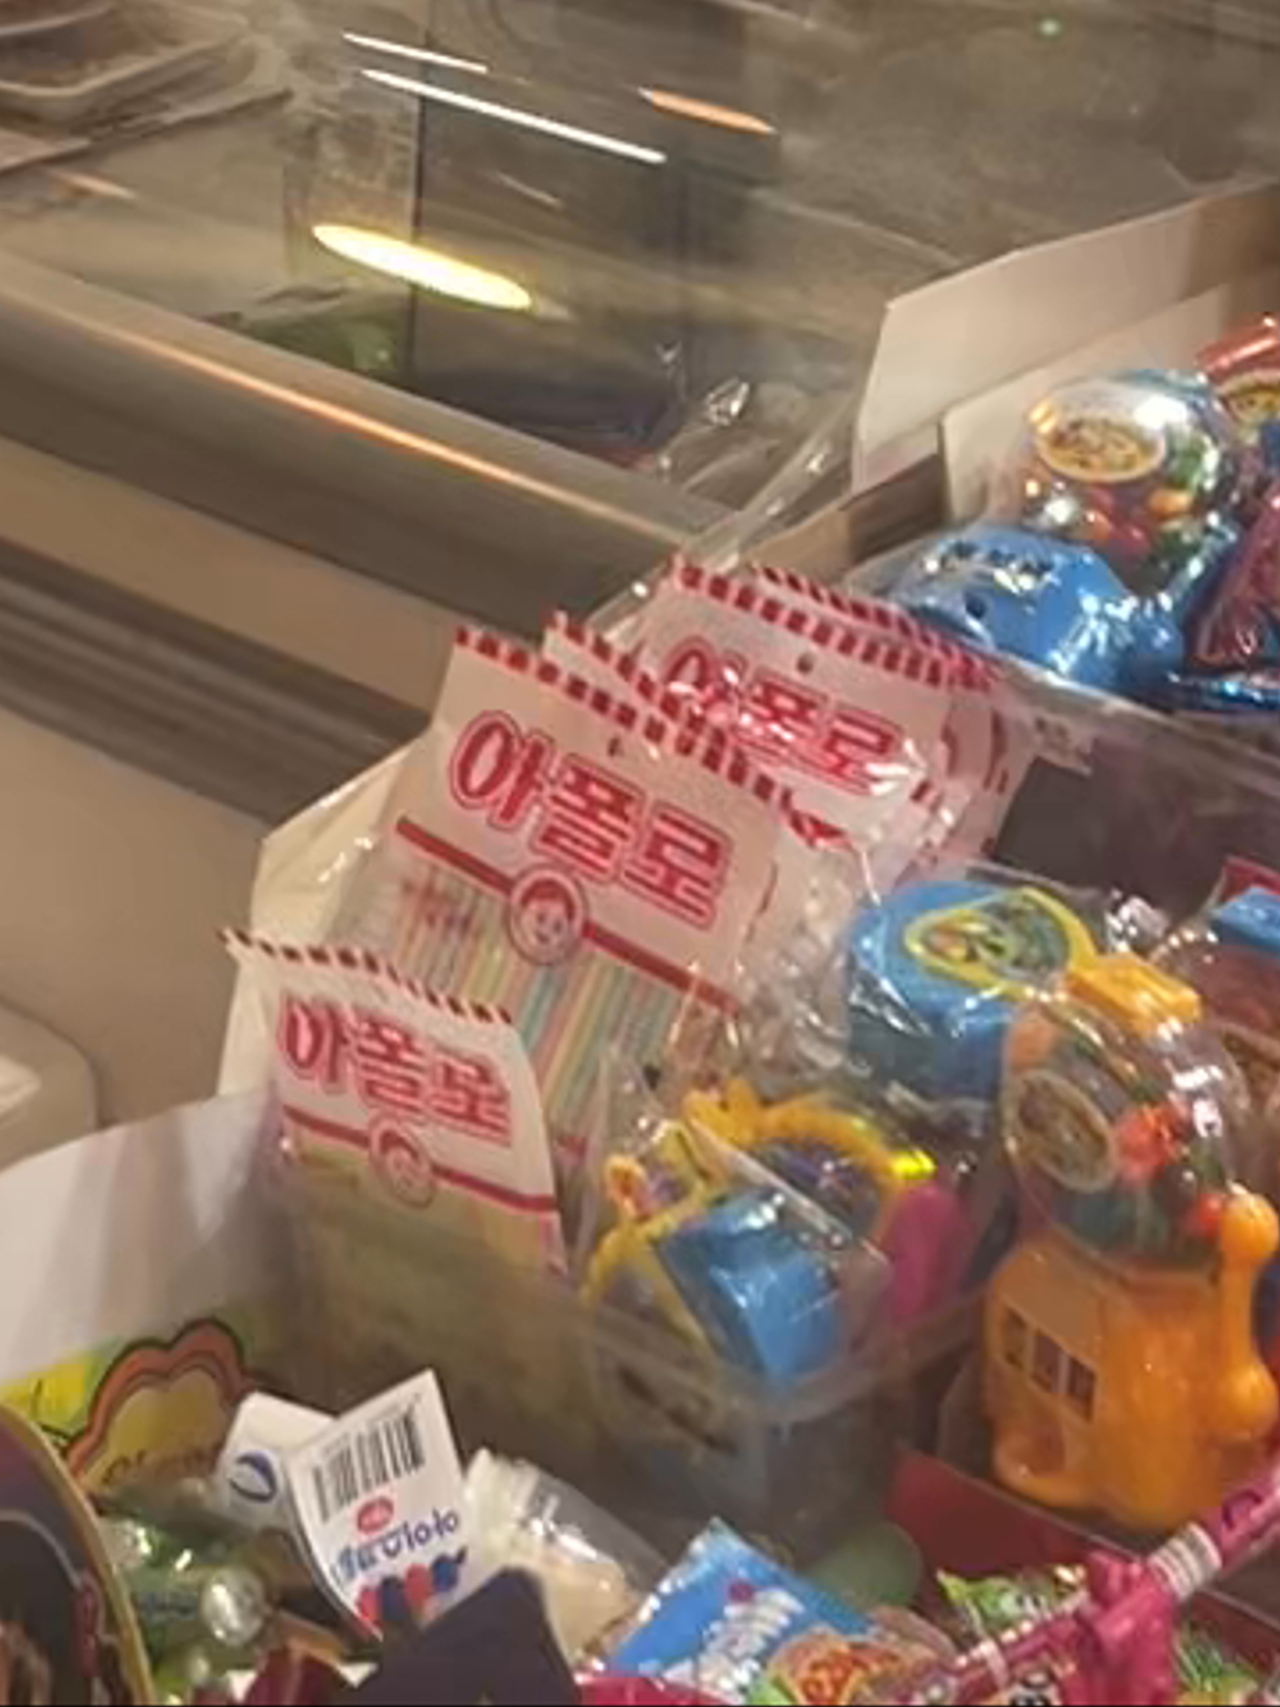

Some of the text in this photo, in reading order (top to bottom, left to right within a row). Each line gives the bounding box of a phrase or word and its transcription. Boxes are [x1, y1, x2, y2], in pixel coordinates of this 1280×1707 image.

[656, 633, 919, 800] 아폴로
[449, 708, 735, 935] 아폴로
[277, 993, 513, 1150] 아폴로
